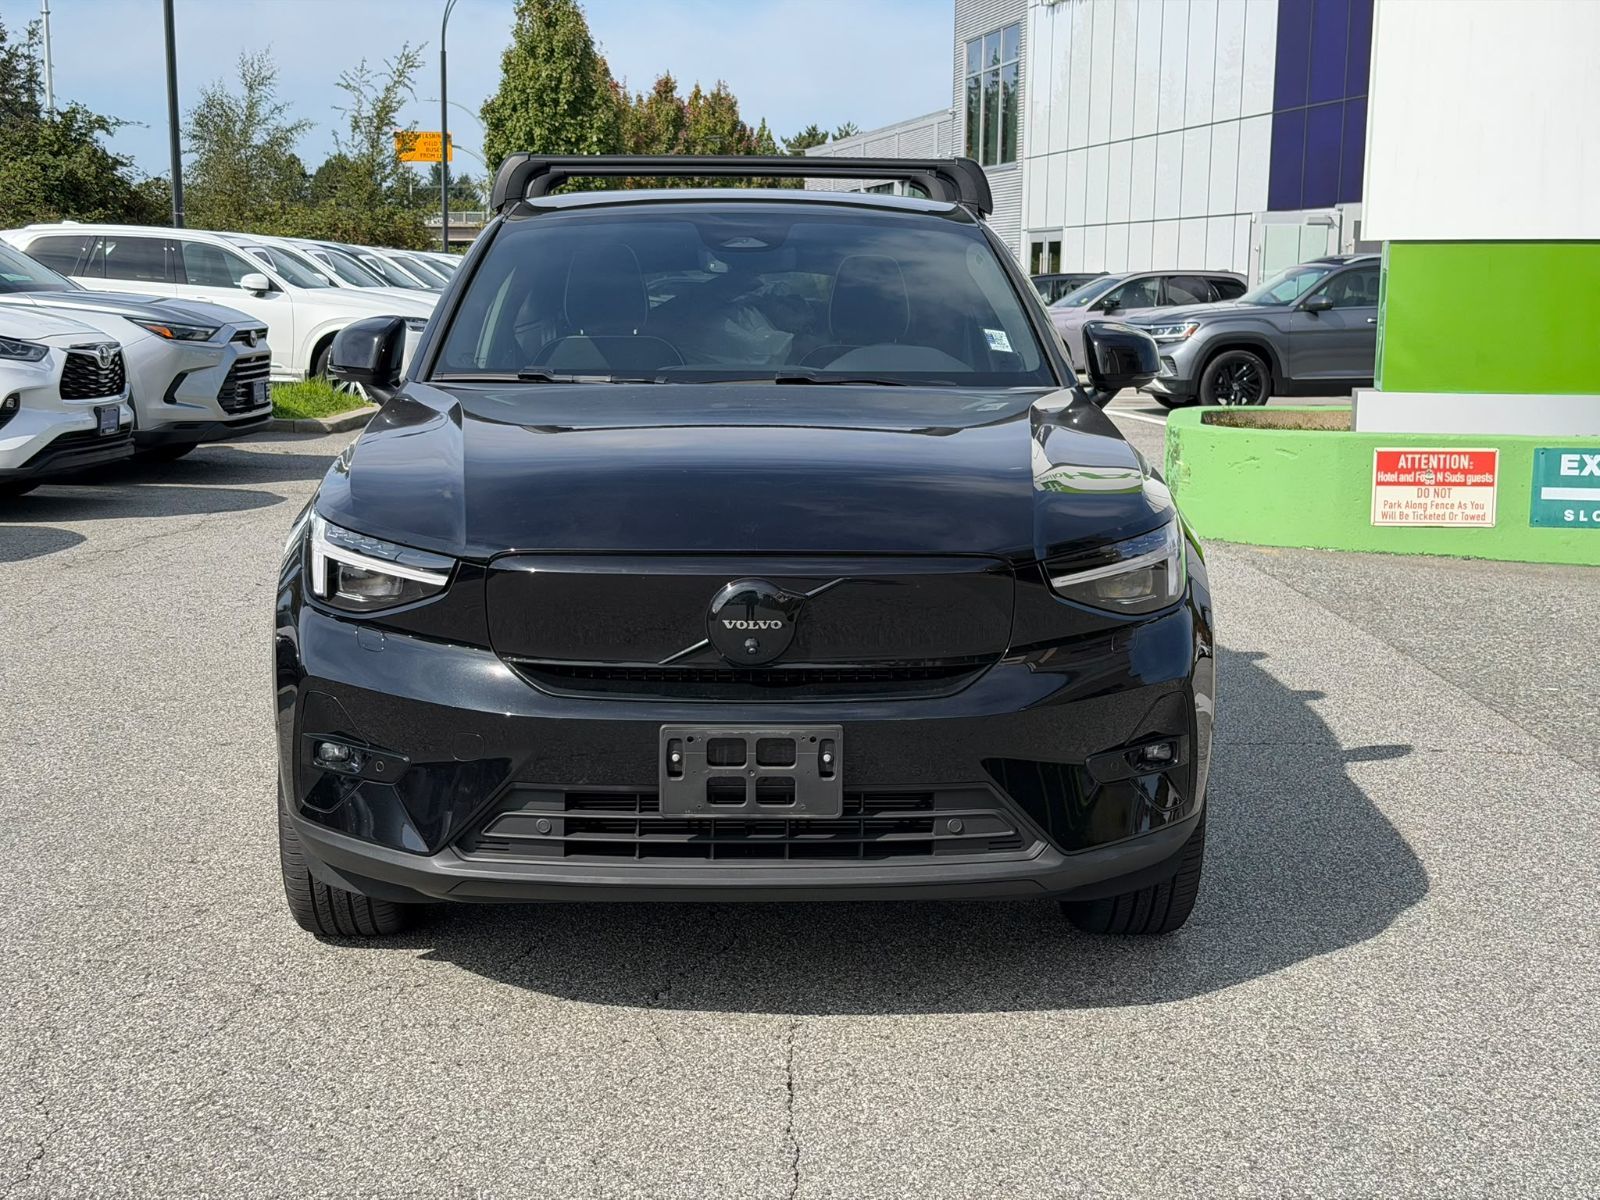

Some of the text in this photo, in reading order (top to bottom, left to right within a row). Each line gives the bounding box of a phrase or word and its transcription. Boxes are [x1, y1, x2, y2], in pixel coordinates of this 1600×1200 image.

[1398, 454, 1474, 470] ATTENTION:
[1378, 470, 1398, 482] Hotel
[1399, 471, 1414, 482] and
[1436, 472, 1444, 482] N
[1444, 472, 1465, 482] Suds
[1466, 472, 1494, 486] guests
[1417, 488, 1452, 498] DO NOT
[1384, 500, 1484, 512] Park Along Fence As You
[1382, 511, 1486, 520] Will Be Ticketed Or Towed
[722, 620, 782, 630] VOLVO
